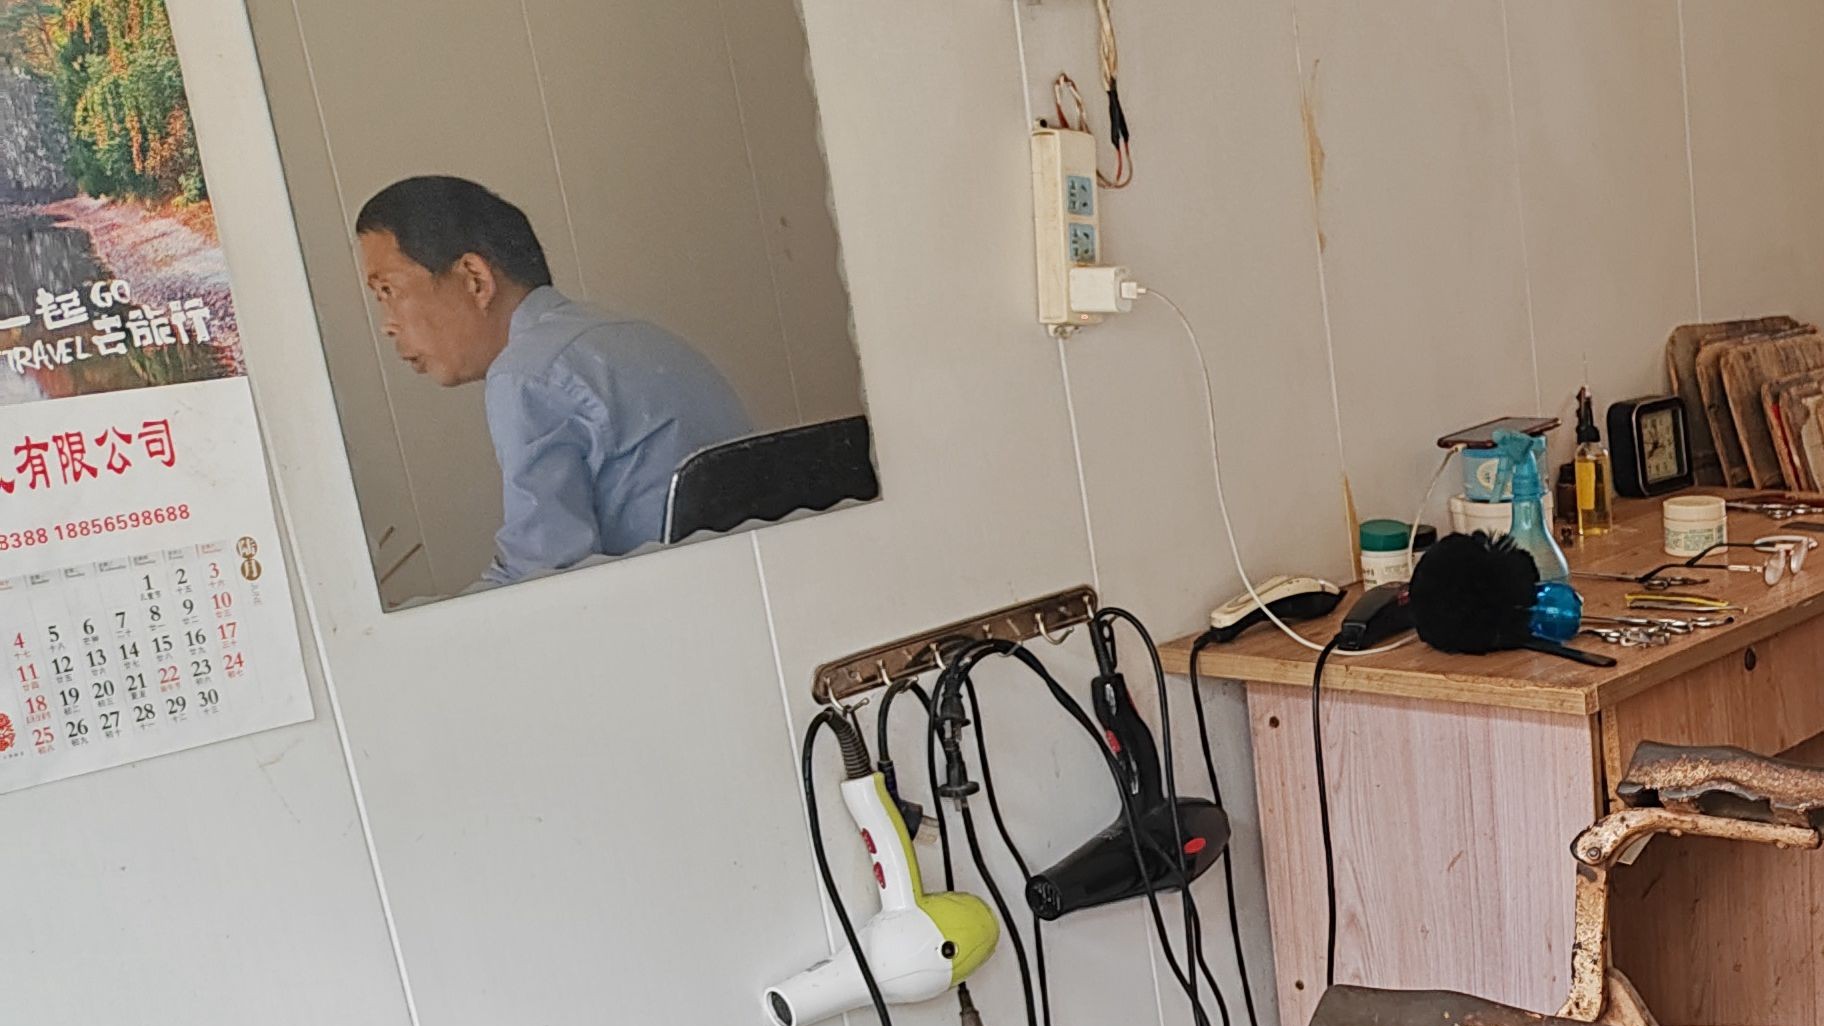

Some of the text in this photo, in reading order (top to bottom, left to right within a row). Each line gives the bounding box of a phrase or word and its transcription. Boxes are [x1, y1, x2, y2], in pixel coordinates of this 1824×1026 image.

[90, 279, 131, 308] GO
[0, 419, 176, 494] 有限公司
[55, 504, 190, 540] 18856598688
[143, 563, 219, 590] 1 2 3
[14, 591, 232, 649] 4 5 6 7 8 9 10
[17, 622, 237, 682] 11 12 13 14 15 16 17
[25, 652, 244, 715] 18 19 20 21 22 23 24
[32, 689, 219, 746] 25 26 27 28 29 30
